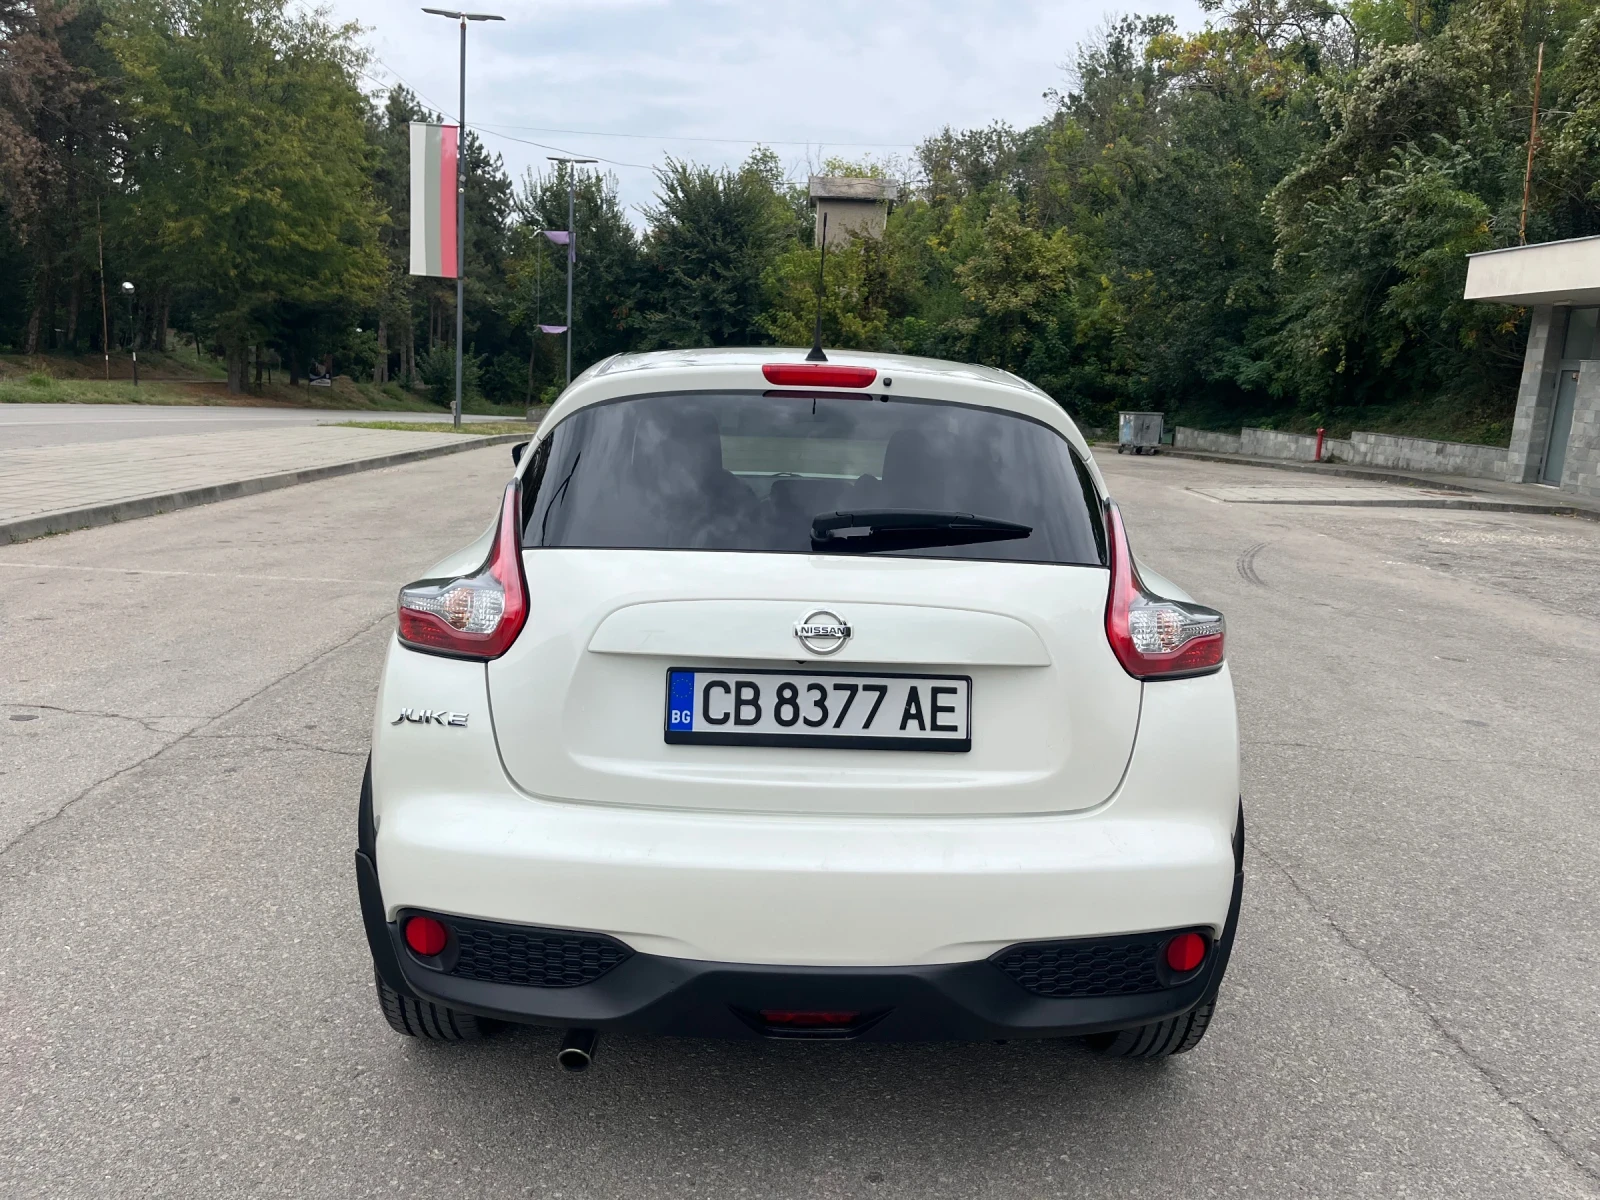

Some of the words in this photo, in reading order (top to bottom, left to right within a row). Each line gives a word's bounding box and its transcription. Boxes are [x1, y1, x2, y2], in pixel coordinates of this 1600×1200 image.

[801, 626, 845, 635] NISSAN
[702, 680, 762, 726] CB
[774, 682, 888, 728] 8377
[899, 686, 958, 732] AE
[391, 707, 469, 727] JUKE
[671, 710, 691, 724] BG
